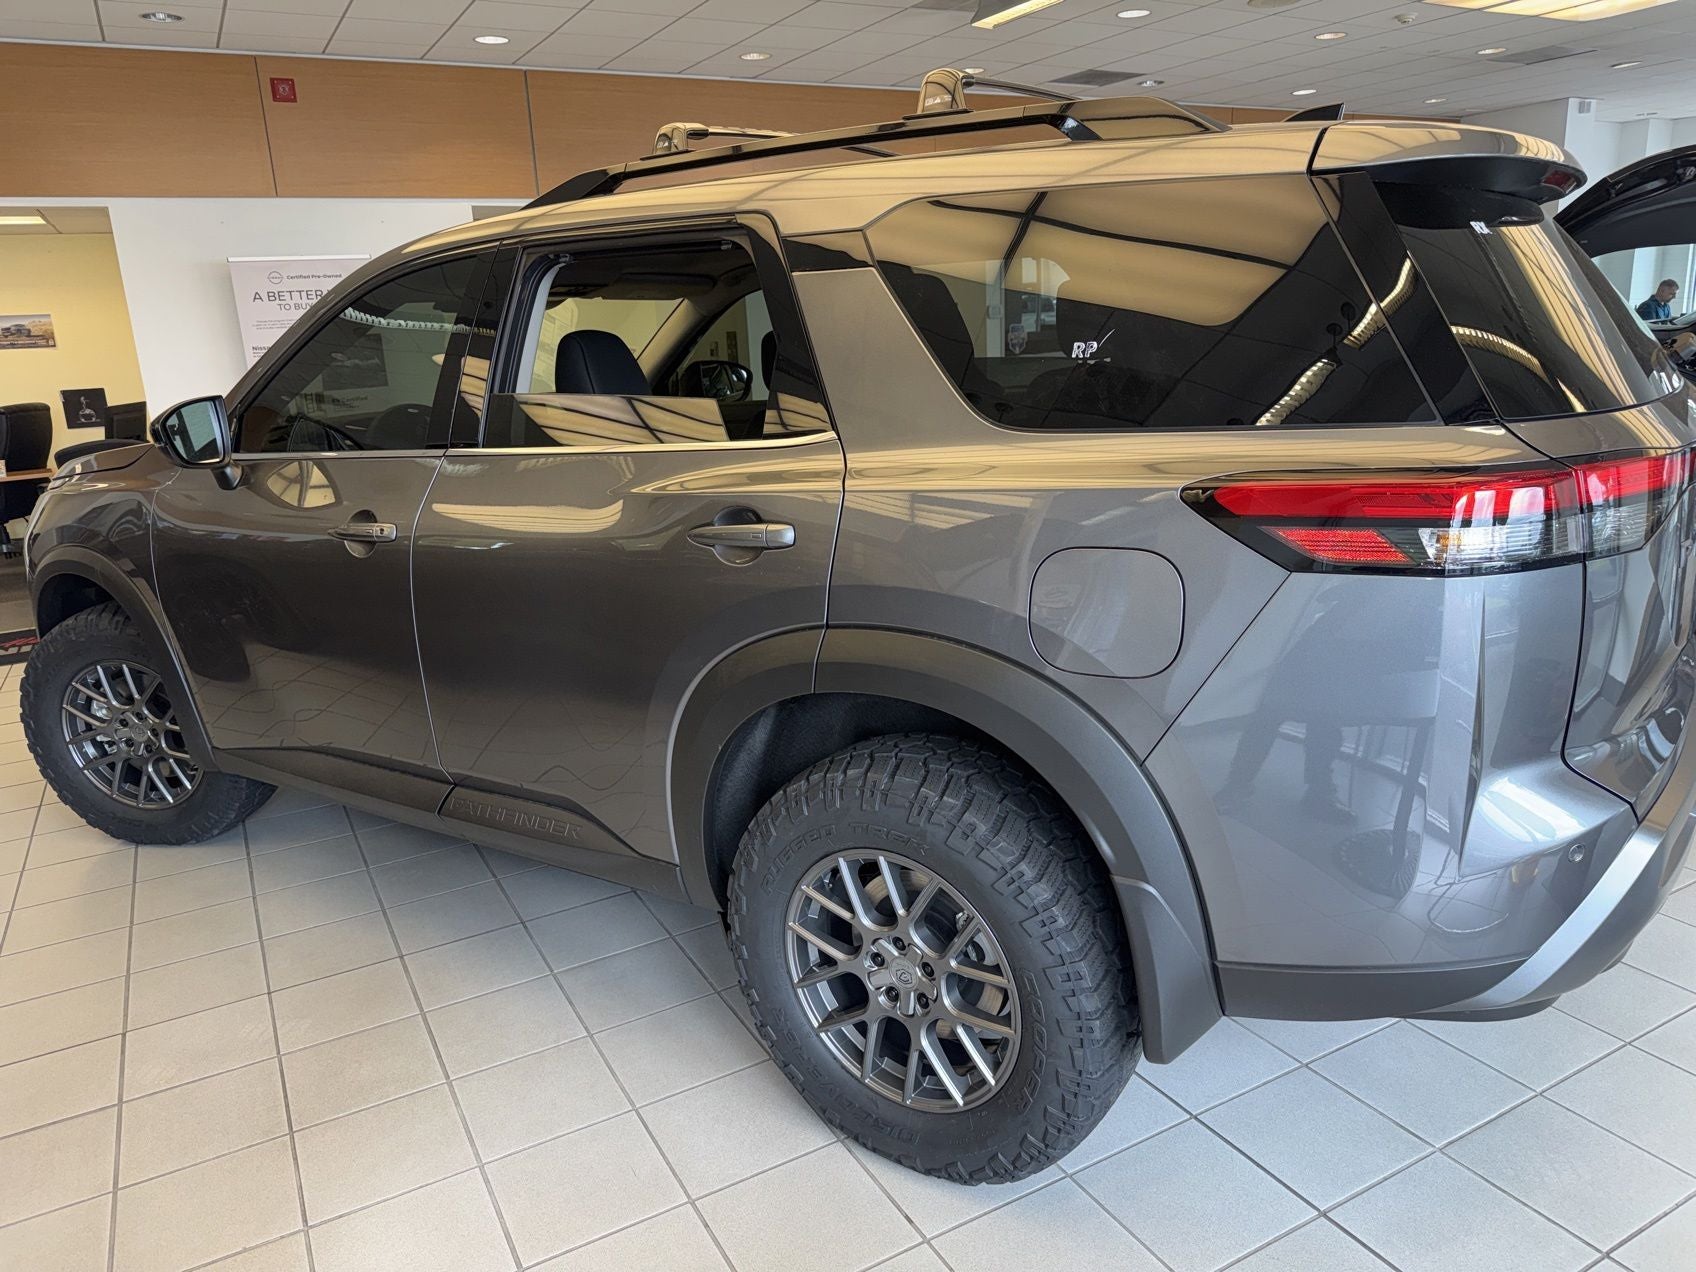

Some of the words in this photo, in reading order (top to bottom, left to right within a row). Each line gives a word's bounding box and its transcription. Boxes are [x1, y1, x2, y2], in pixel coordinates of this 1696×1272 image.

[252, 291, 264, 302] A
[266, 289, 324, 302] BETTER
[277, 303, 292, 311] TO
[449, 797, 583, 840] PATHFINDER
[1017, 967, 1047, 1116] COOPER
